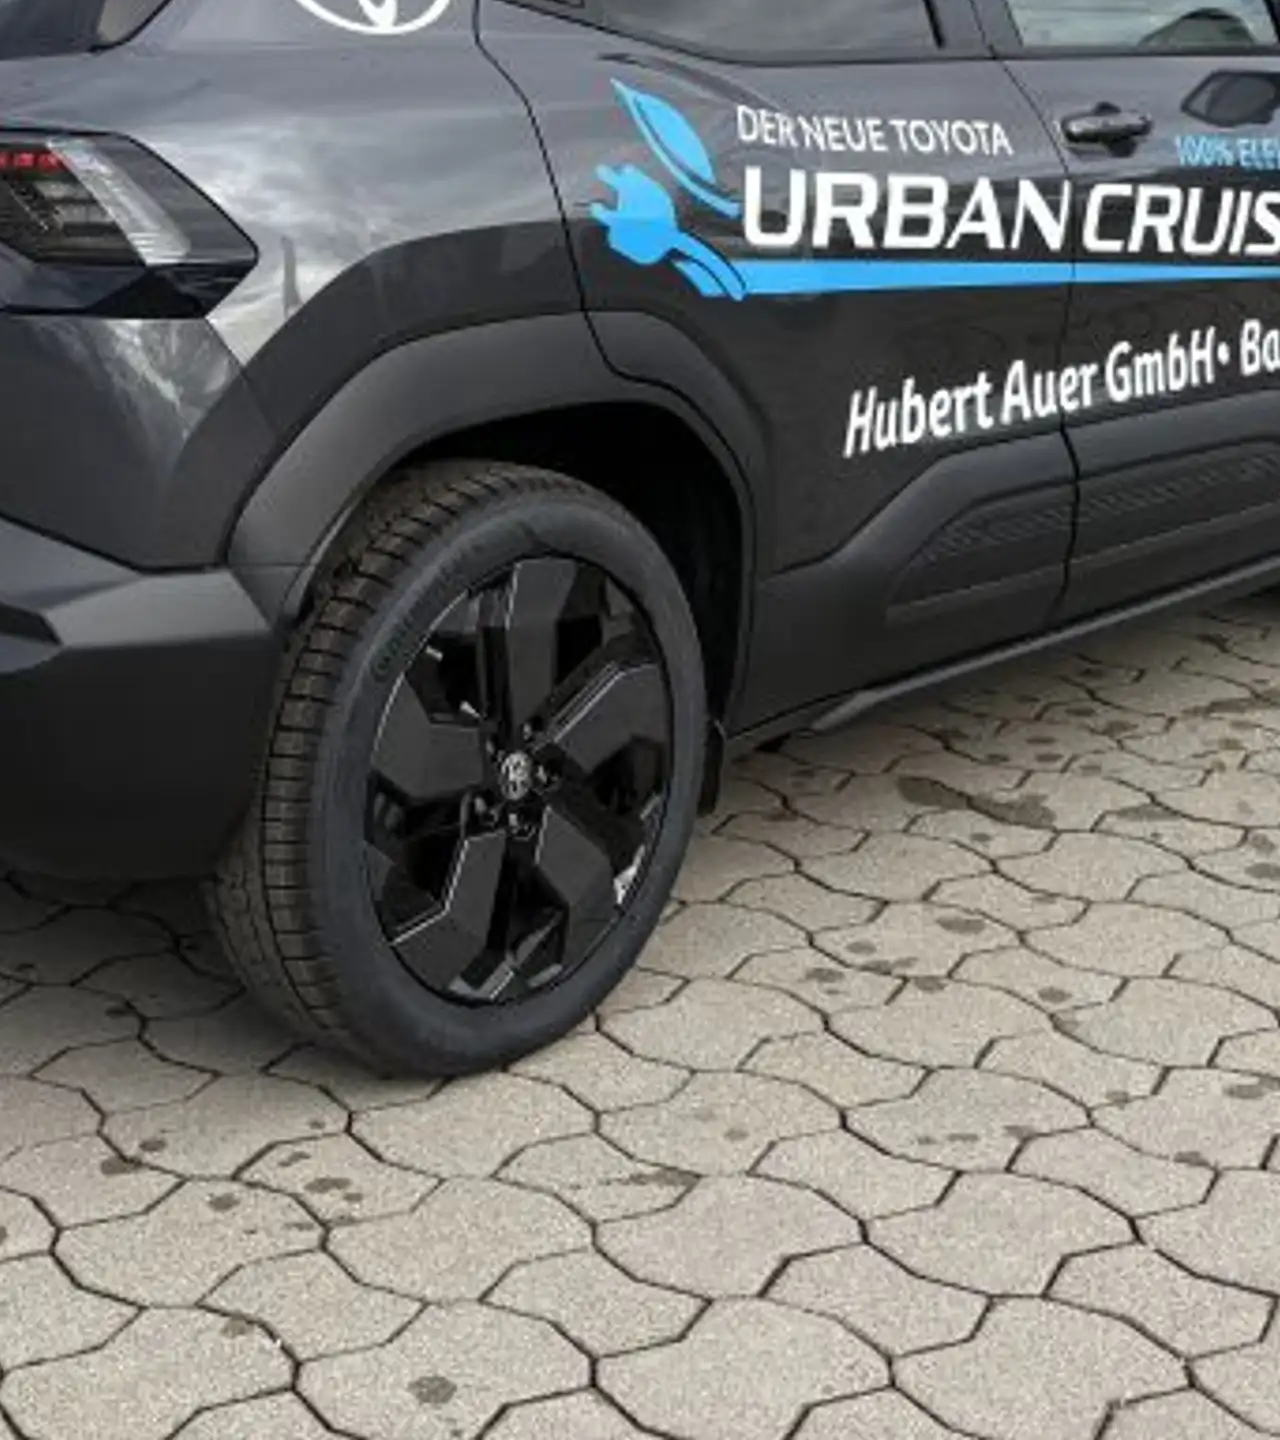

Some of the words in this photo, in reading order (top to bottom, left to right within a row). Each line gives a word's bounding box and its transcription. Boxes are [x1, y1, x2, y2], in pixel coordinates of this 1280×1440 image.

[737, 104, 798, 148] DER
[798, 115, 889, 152] NEUE
[889, 118, 1014, 156] TOYOTA
[1176, 134, 1235, 168] 100%
[743, 165, 1071, 253] URBAN
[843, 374, 995, 459] Hubert
[1000, 359, 1099, 426] Auer
[1104, 325, 1217, 404] GmbH
